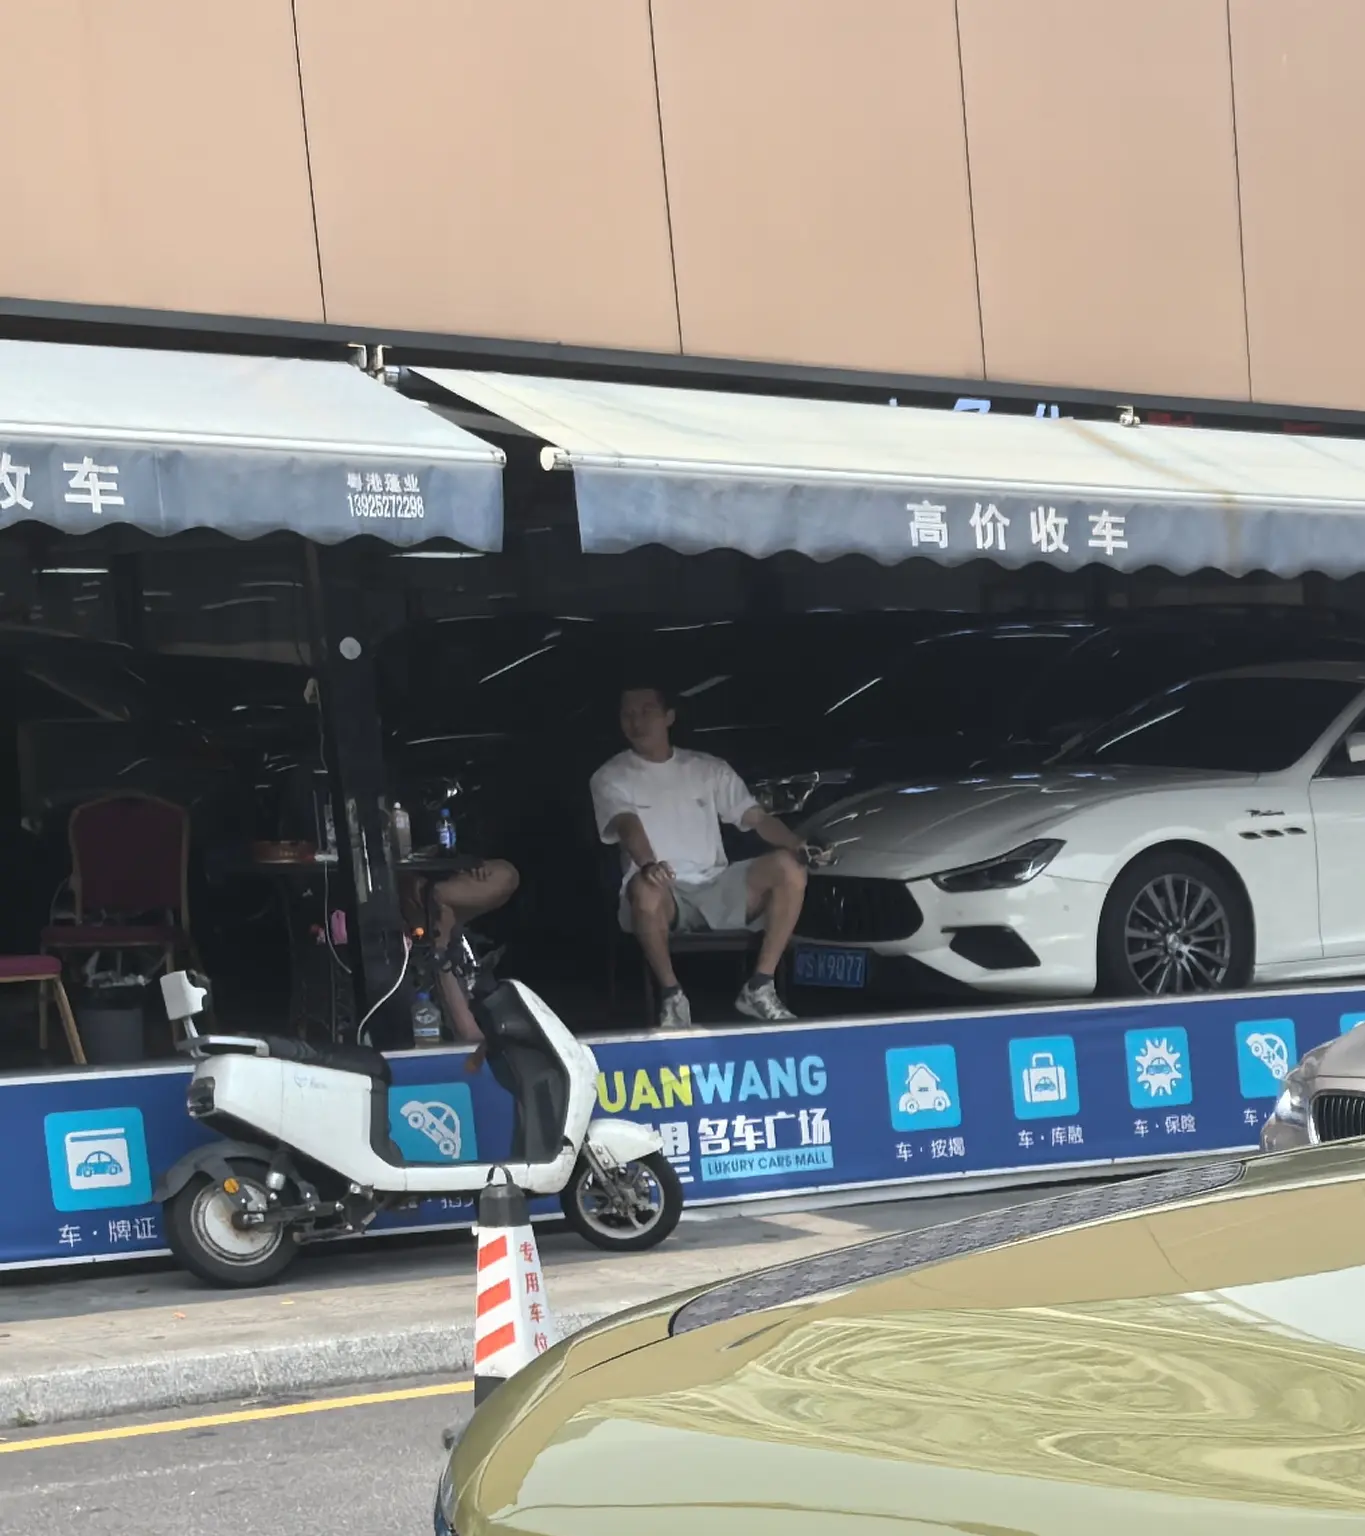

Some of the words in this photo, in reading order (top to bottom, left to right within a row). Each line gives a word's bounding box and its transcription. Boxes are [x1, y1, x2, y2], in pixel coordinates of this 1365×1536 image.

[906, 500, 1129, 556] 高价收车
[697, 1107, 831, 1155] 名车广场
[707, 1159, 754, 1175] LUXURY
[757, 1156, 792, 1170] CARS
[794, 1152, 828, 1166] MALL
